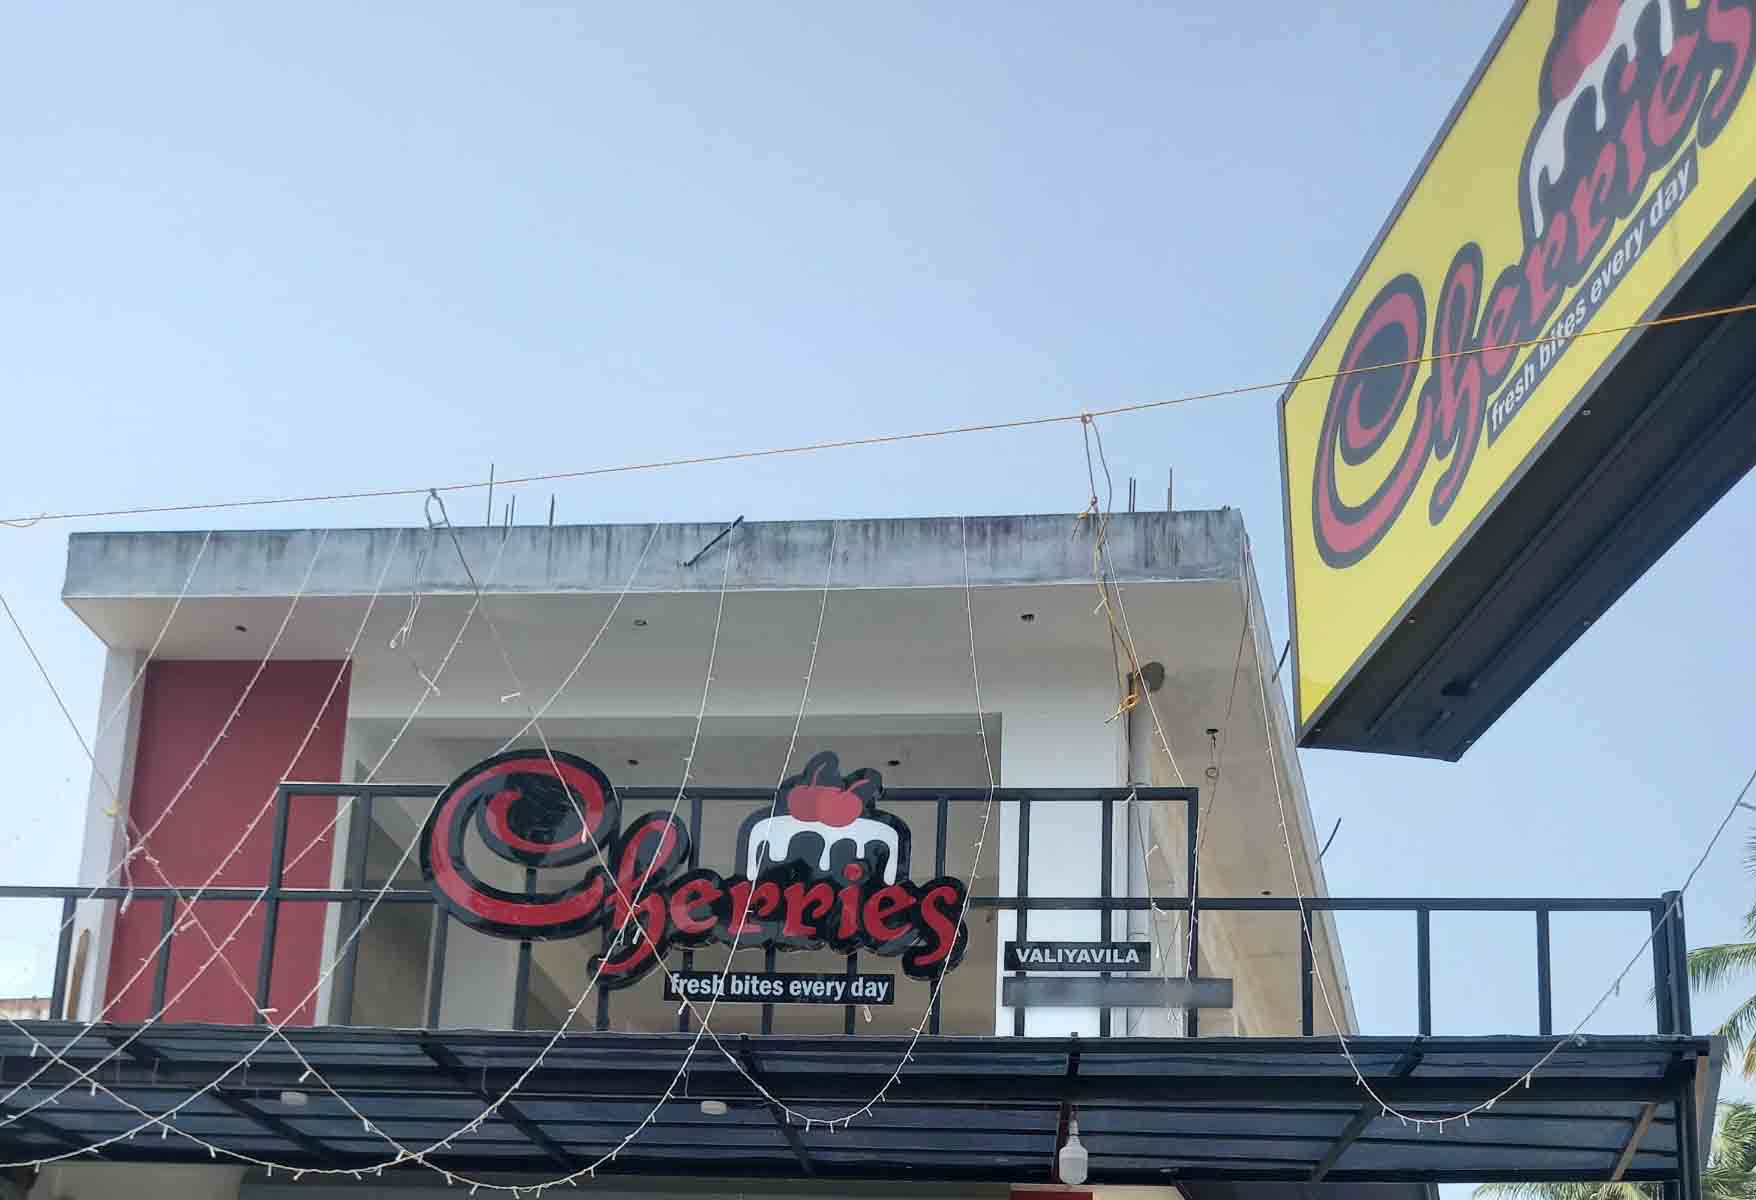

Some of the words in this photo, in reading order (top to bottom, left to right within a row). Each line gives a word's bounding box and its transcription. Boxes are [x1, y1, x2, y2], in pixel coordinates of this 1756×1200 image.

[1312, 0, 1756, 568] Cherries
[1490, 361, 1536, 432] fresh
[1538, 299, 1587, 373] bites
[1590, 217, 1646, 299] every
[1650, 159, 1691, 228] day
[423, 751, 967, 985] Cherries
[1015, 947, 1140, 965] VALIYAVILA
[669, 972, 724, 996] fresh
[731, 974, 784, 997] bites
[789, 978, 845, 1002] every
[850, 977, 890, 1003] day
